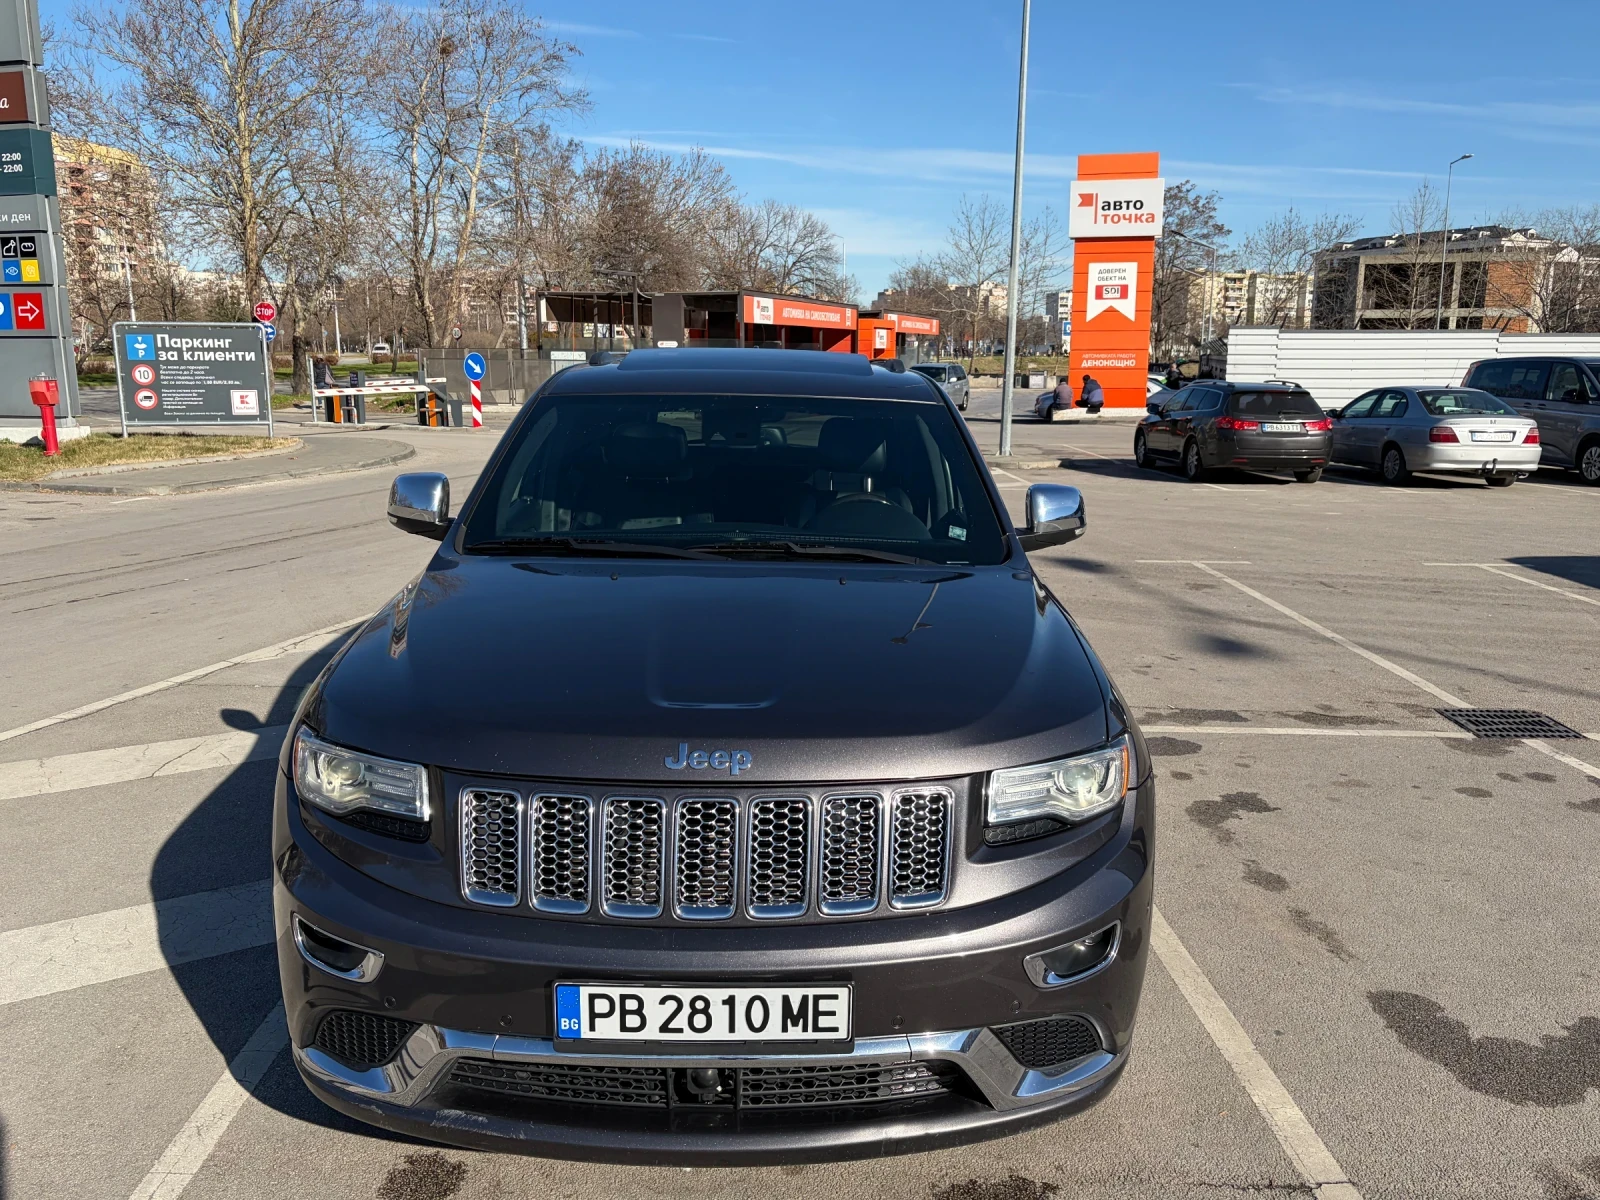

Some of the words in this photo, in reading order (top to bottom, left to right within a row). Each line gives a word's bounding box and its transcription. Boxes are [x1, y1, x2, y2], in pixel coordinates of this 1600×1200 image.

[2, 153, 21, 161] 22:00
[3, 164, 23, 173] 22:00
[1101, 199, 1144, 211] авто
[11, 213, 31, 224] ден
[1101, 212, 1155, 224] точка
[156, 334, 232, 351] Паркинг
[138, 349, 145, 358] P
[158, 350, 178, 361] за
[183, 351, 256, 361] клиенти
[1081, 359, 1136, 368] ДЕНОНОЩНО
[138, 369, 149, 380] 10
[664, 742, 752, 776] Jeep
[588, 993, 647, 1033] PB
[658, 994, 770, 1034] 2810
[781, 994, 840, 1033] ME
[560, 1018, 579, 1030] BG
